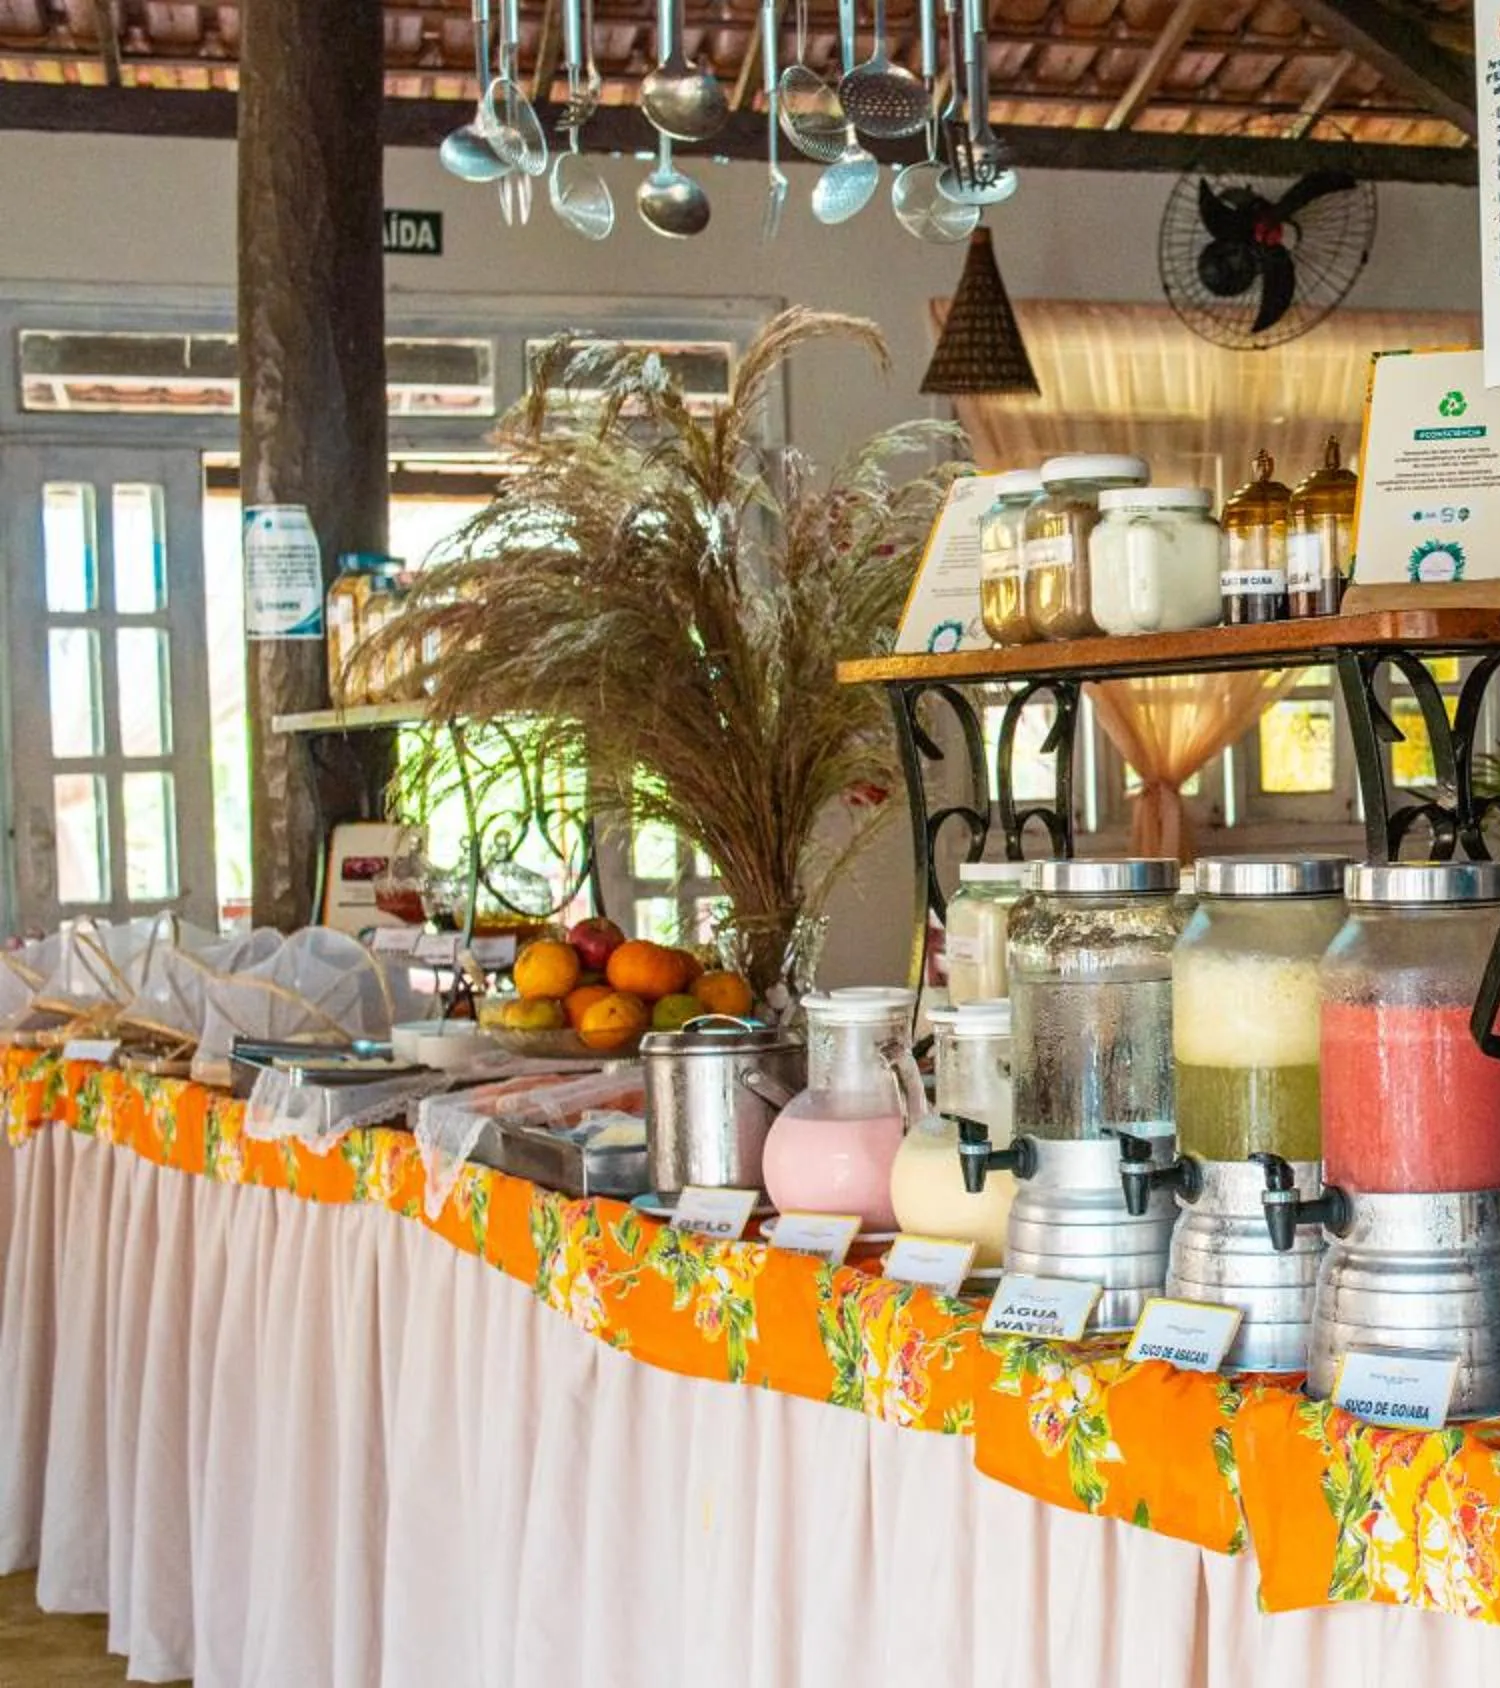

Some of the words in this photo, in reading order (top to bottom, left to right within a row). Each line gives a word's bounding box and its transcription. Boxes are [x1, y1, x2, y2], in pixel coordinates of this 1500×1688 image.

[1001, 1304, 1058, 1319] ÁGUA
[1344, 1398, 1372, 1415] SUCO
[1374, 1402, 1388, 1416] DE
[1391, 1404, 1430, 1421] GOIABA
